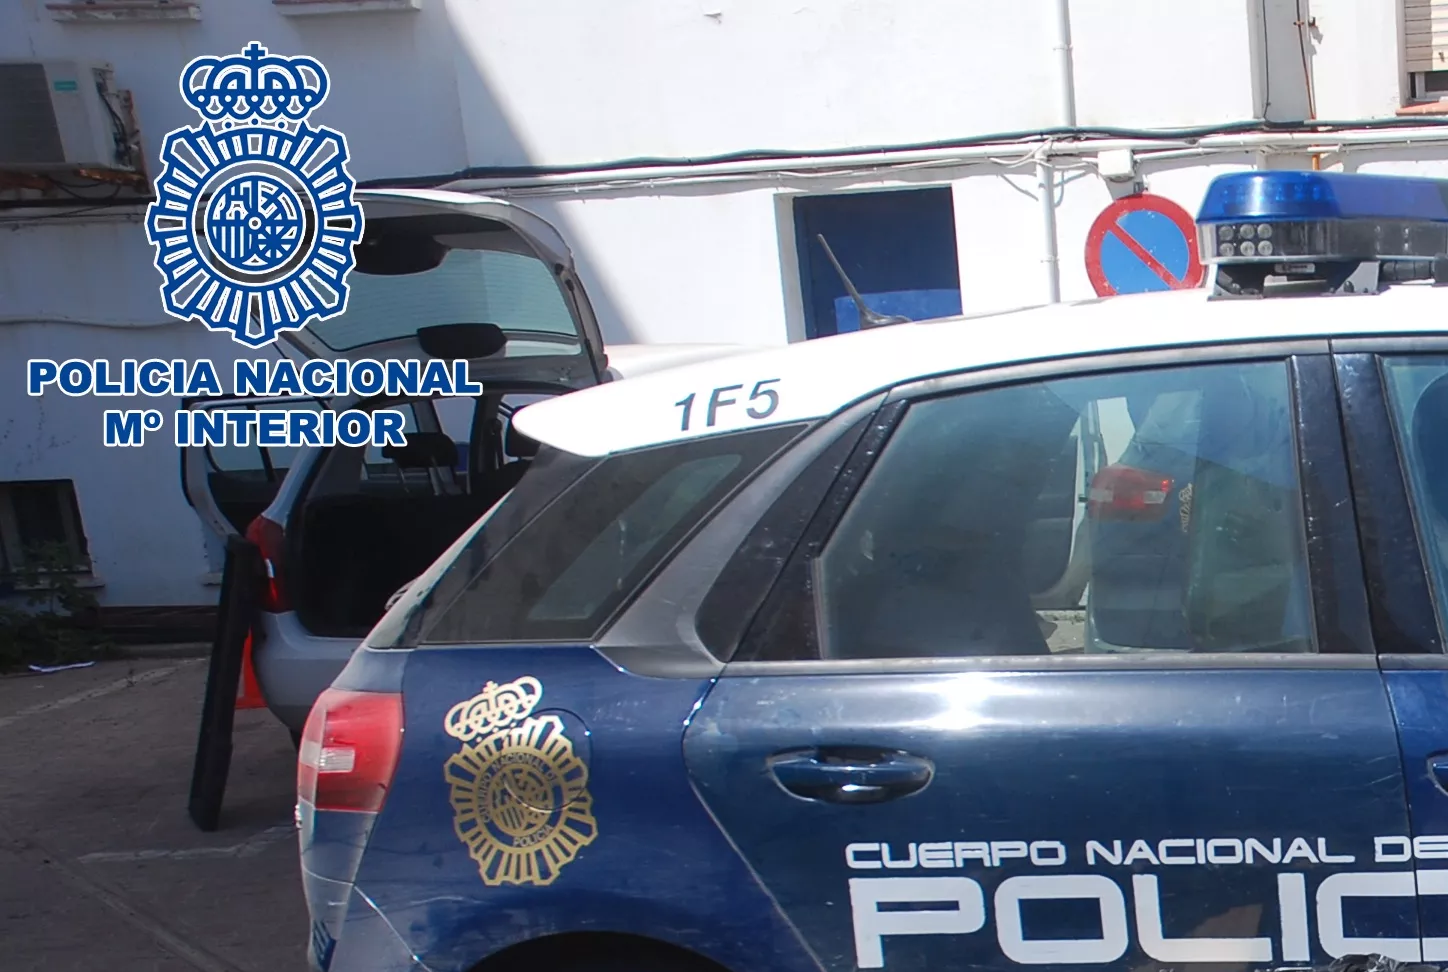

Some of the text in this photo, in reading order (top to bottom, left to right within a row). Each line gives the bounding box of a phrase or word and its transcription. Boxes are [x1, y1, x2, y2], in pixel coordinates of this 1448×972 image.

[673, 376, 780, 433] 1F5
[845, 840, 1067, 869] CUERPO
[1085, 836, 1355, 865] NACIONAL
